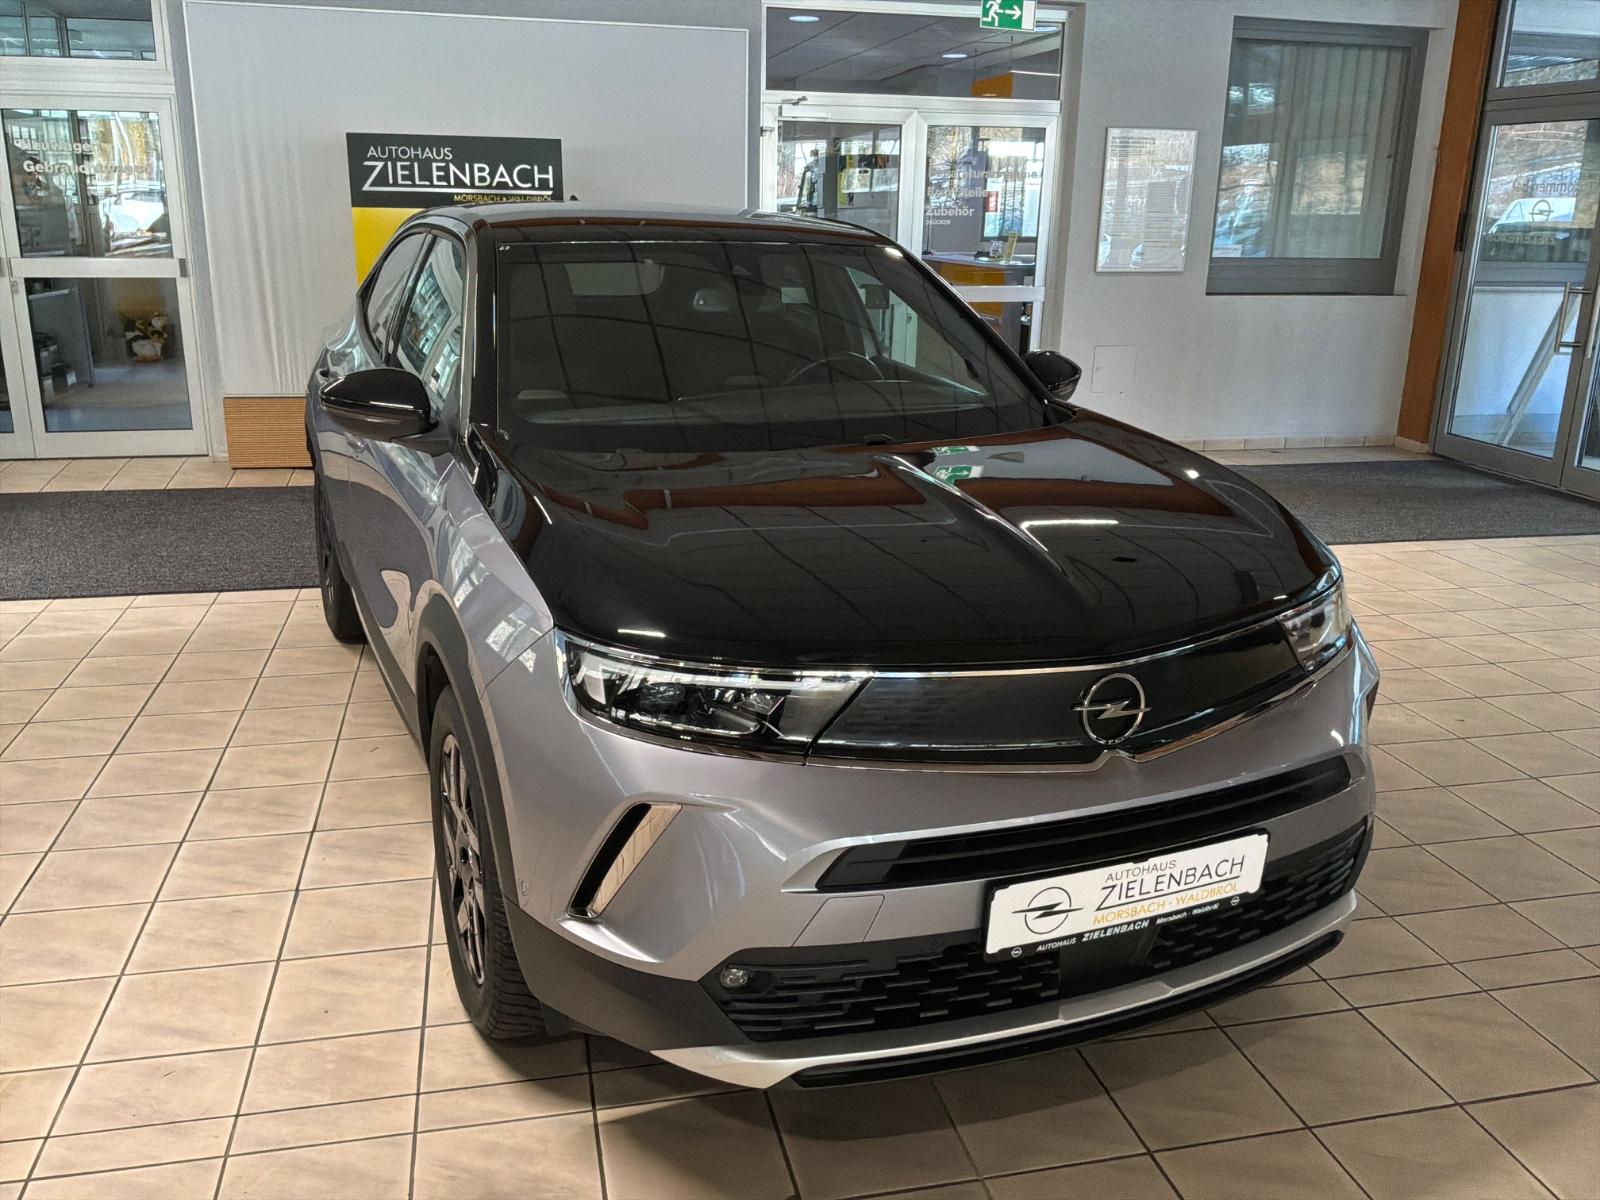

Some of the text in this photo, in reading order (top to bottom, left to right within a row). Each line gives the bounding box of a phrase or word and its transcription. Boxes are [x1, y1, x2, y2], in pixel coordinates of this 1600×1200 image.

[367, 145, 453, 160] AUTOHAUS
[361, 161, 554, 192] ZIELENBACH
[454, 194, 500, 202] MORSBACH
[925, 205, 975, 216] Zubehör
[1094, 854, 1245, 912] ZIELENBACH
[1105, 859, 1177, 883] AUTOHAUS
[1093, 901, 1166, 926] MORSBACH
[1036, 902, 1220, 952] AUTOHAUS ZIELENBACH Morsbach Waldbröl
